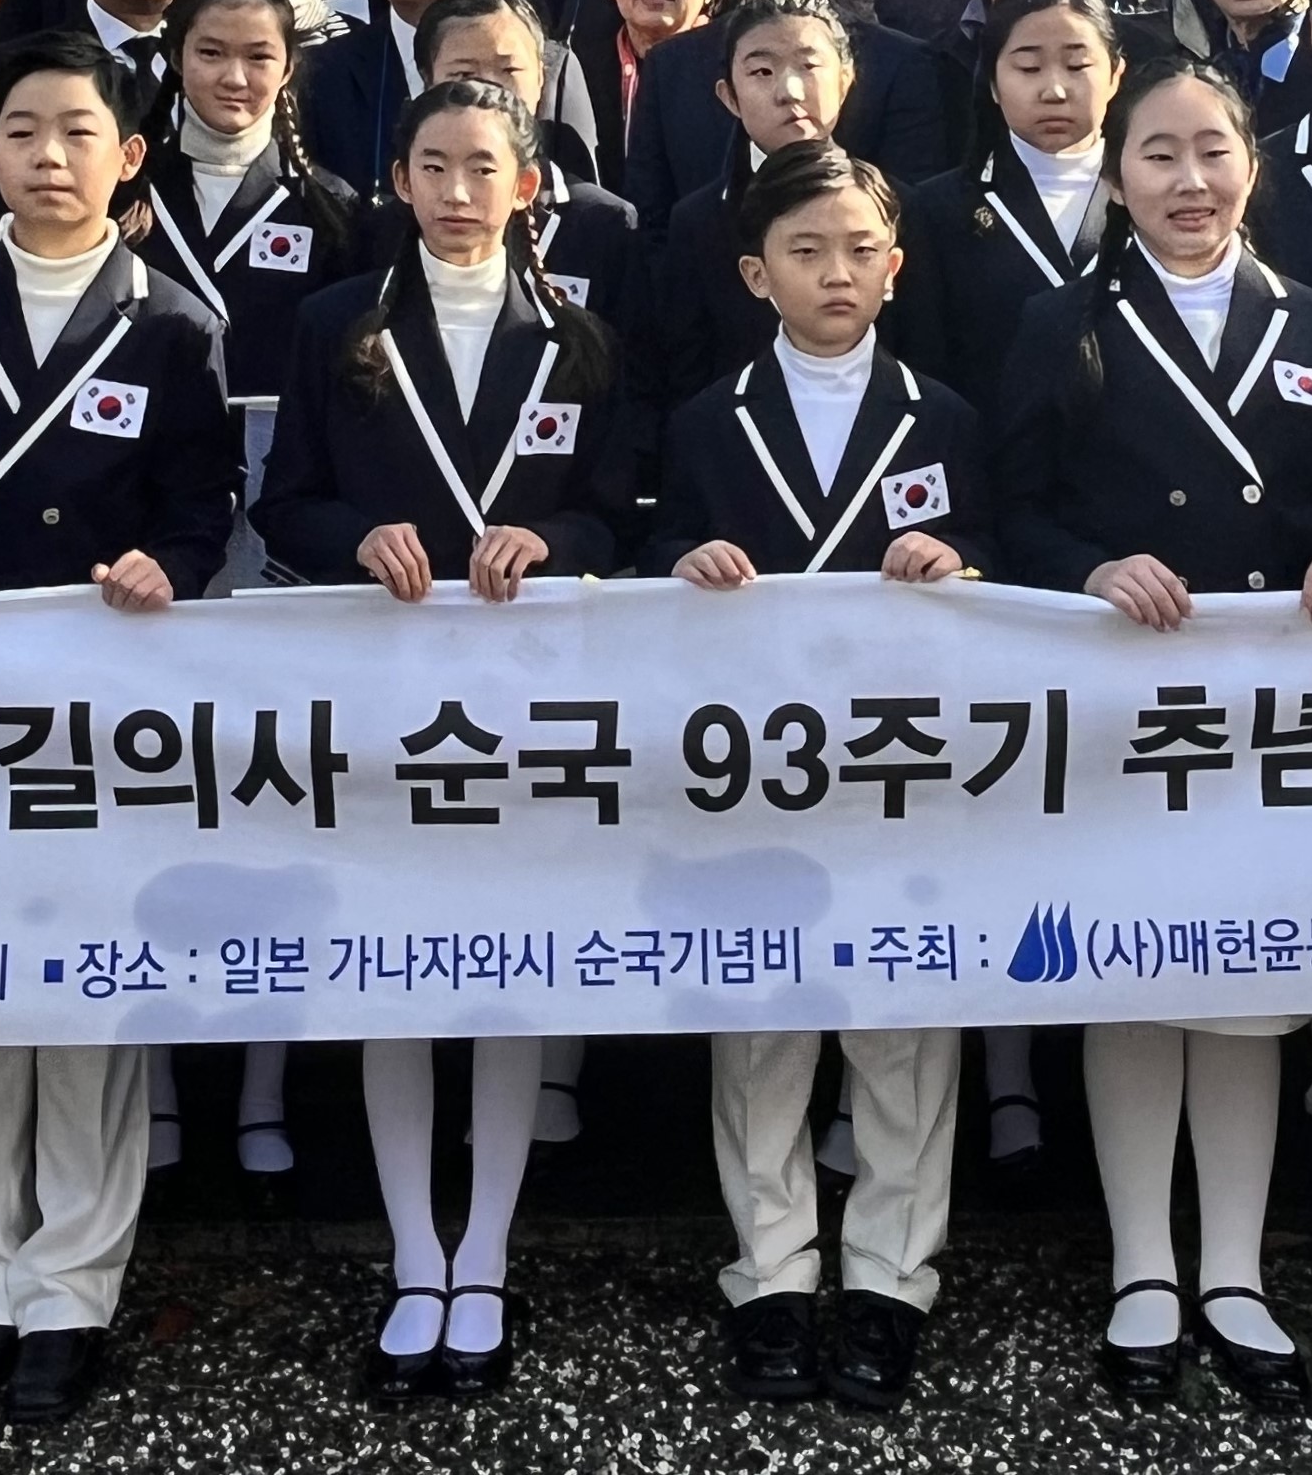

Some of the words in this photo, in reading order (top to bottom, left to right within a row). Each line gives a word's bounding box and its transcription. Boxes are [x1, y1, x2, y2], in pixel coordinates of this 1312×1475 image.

[395, 700, 632, 826] 순국
[682, 689, 1068, 819] 93주기
[76, 940, 167, 999] 장소
[220, 936, 310, 995] 일본
[328, 931, 554, 992] 가나자와시
[574, 926, 802, 987] 순국기념비
[867, 924, 957, 982] 주최
